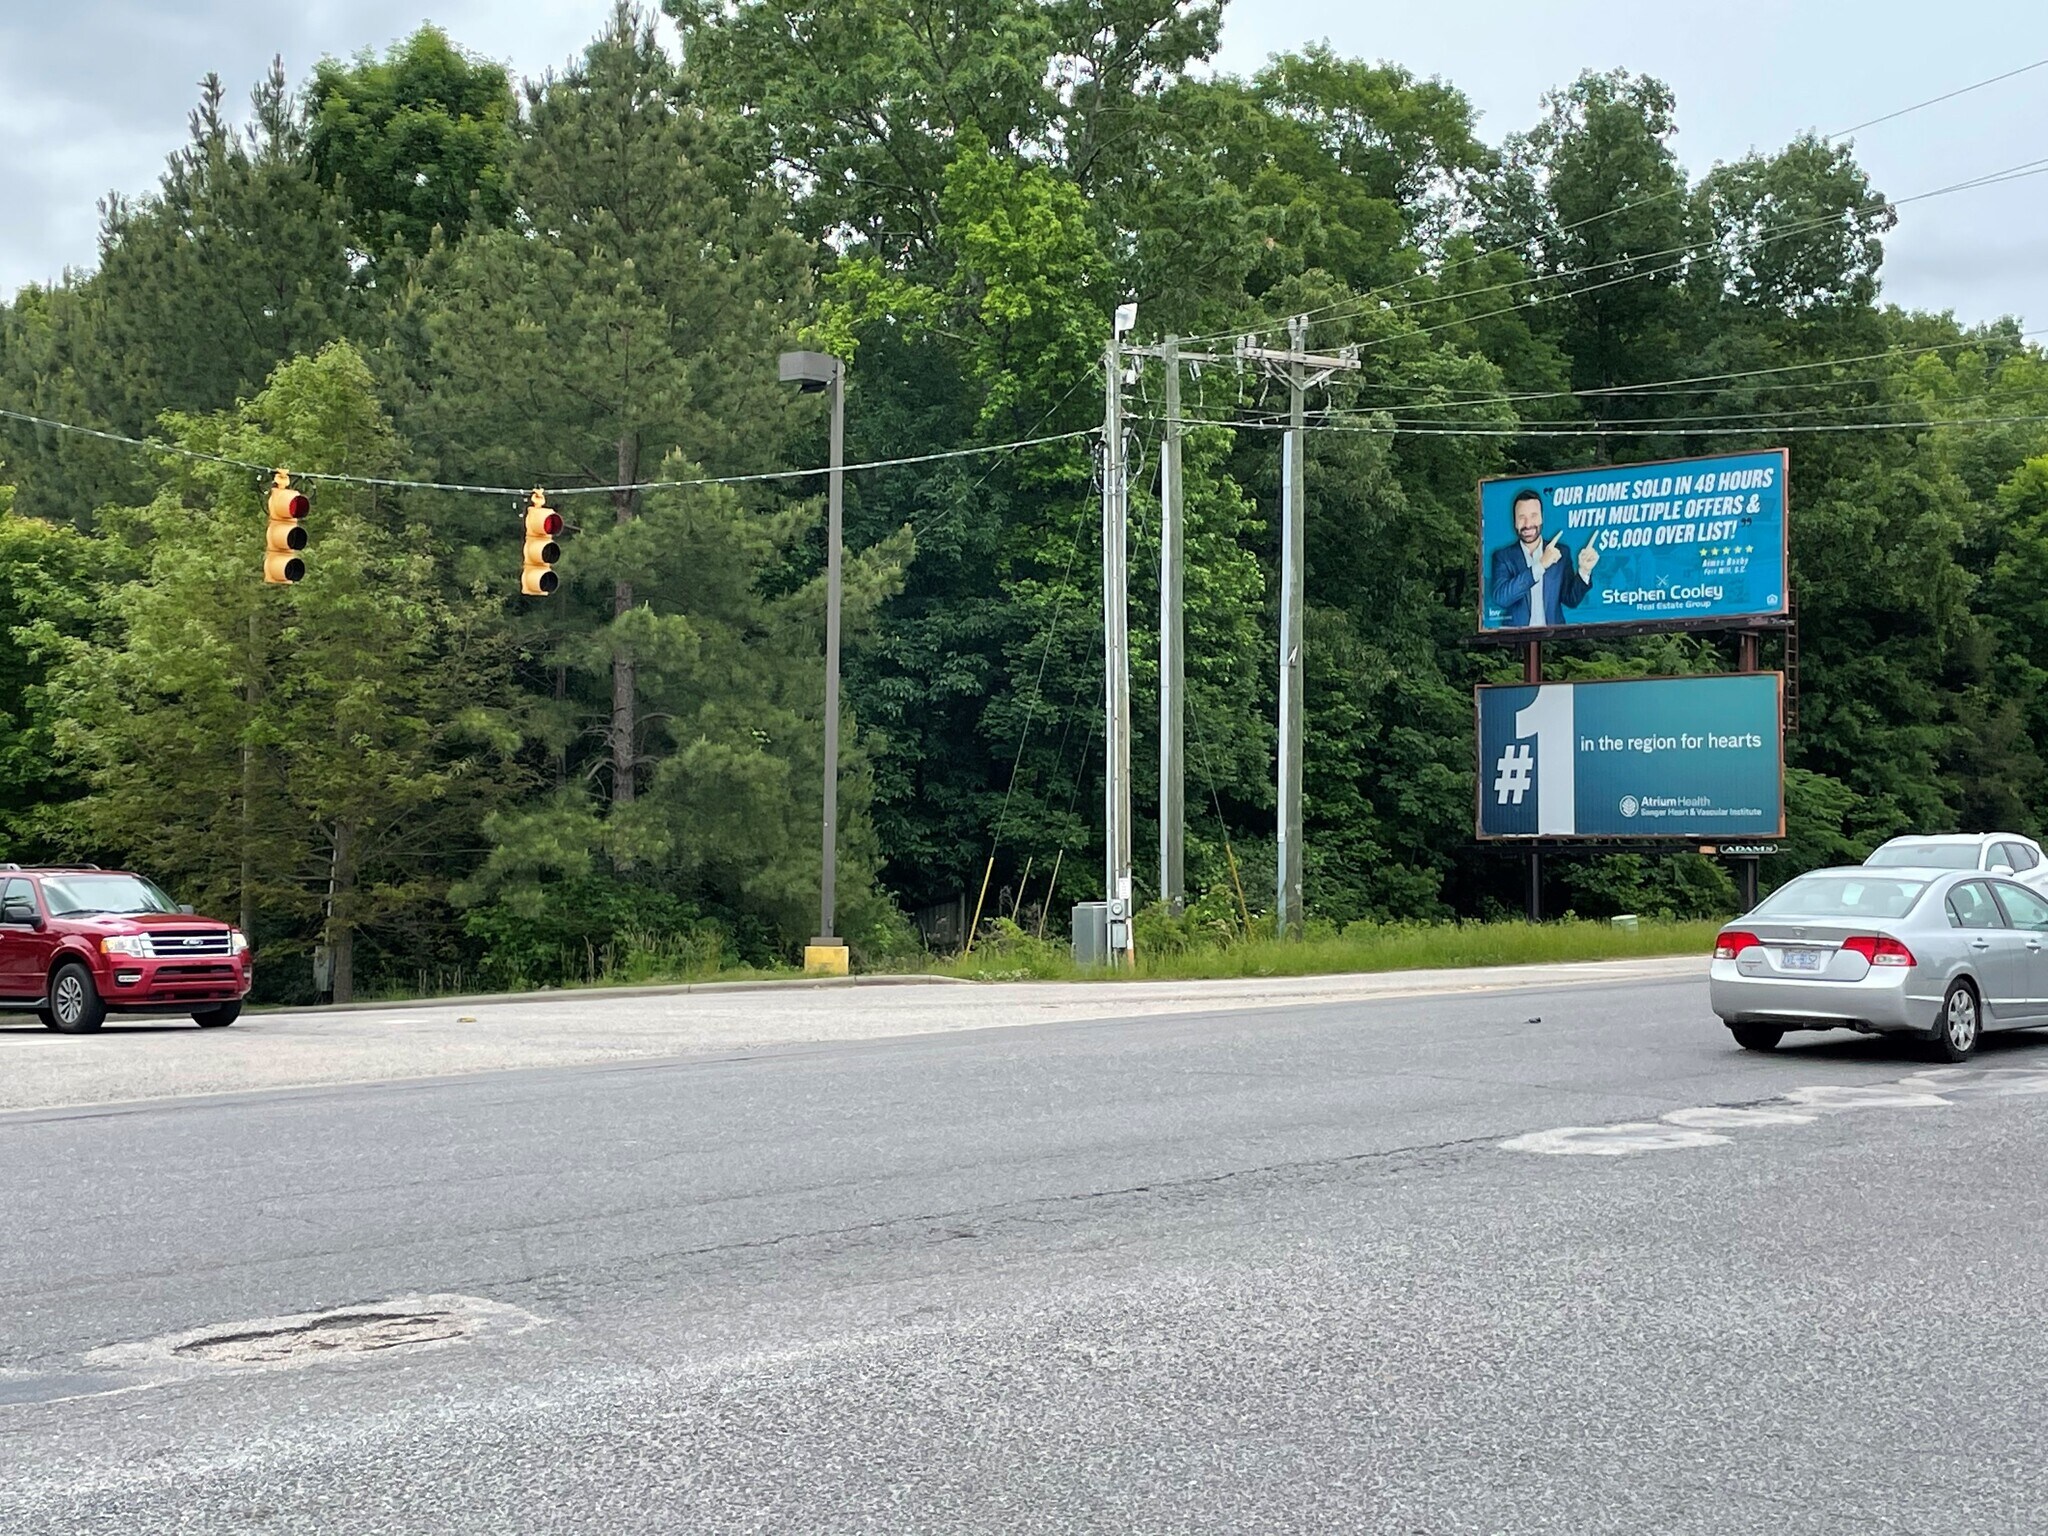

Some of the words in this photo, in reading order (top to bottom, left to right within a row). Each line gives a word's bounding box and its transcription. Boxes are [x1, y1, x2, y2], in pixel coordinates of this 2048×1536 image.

[1586, 481, 1629, 503] HOME
[1632, 478, 1671, 499] SOLD
[1675, 476, 1692, 495] IN
[1694, 473, 1714, 493] 48
[1719, 468, 1774, 491] HOURS
[1568, 508, 1605, 528] WITH
[1608, 502, 1680, 525] MULTIPLE
[1684, 496, 1743, 519] OFFERS
[1746, 494, 1760, 514] &
[1599, 527, 1651, 551] $6,000
[1655, 523, 1694, 544] OVER
[1602, 587, 1665, 605] Stephen
[1670, 583, 1723, 600] Cooley
[1637, 603, 1655, 611] Real
[1656, 601, 1683, 610] Estate
[1685, 600, 1711, 609] Group
[1580, 735, 1594, 751] in
[1598, 734, 1624, 751] the
[1627, 734, 1676, 754] region
[1680, 733, 1704, 749] for
[1708, 732, 1762, 748] hearts
[1641, 796, 1676, 807] Atrium
[1677, 796, 1710, 806] Health
[1668, 808, 1688, 816] Heart
[1696, 808, 1728, 816] Vascular
[1729, 807, 1762, 815] Institute
